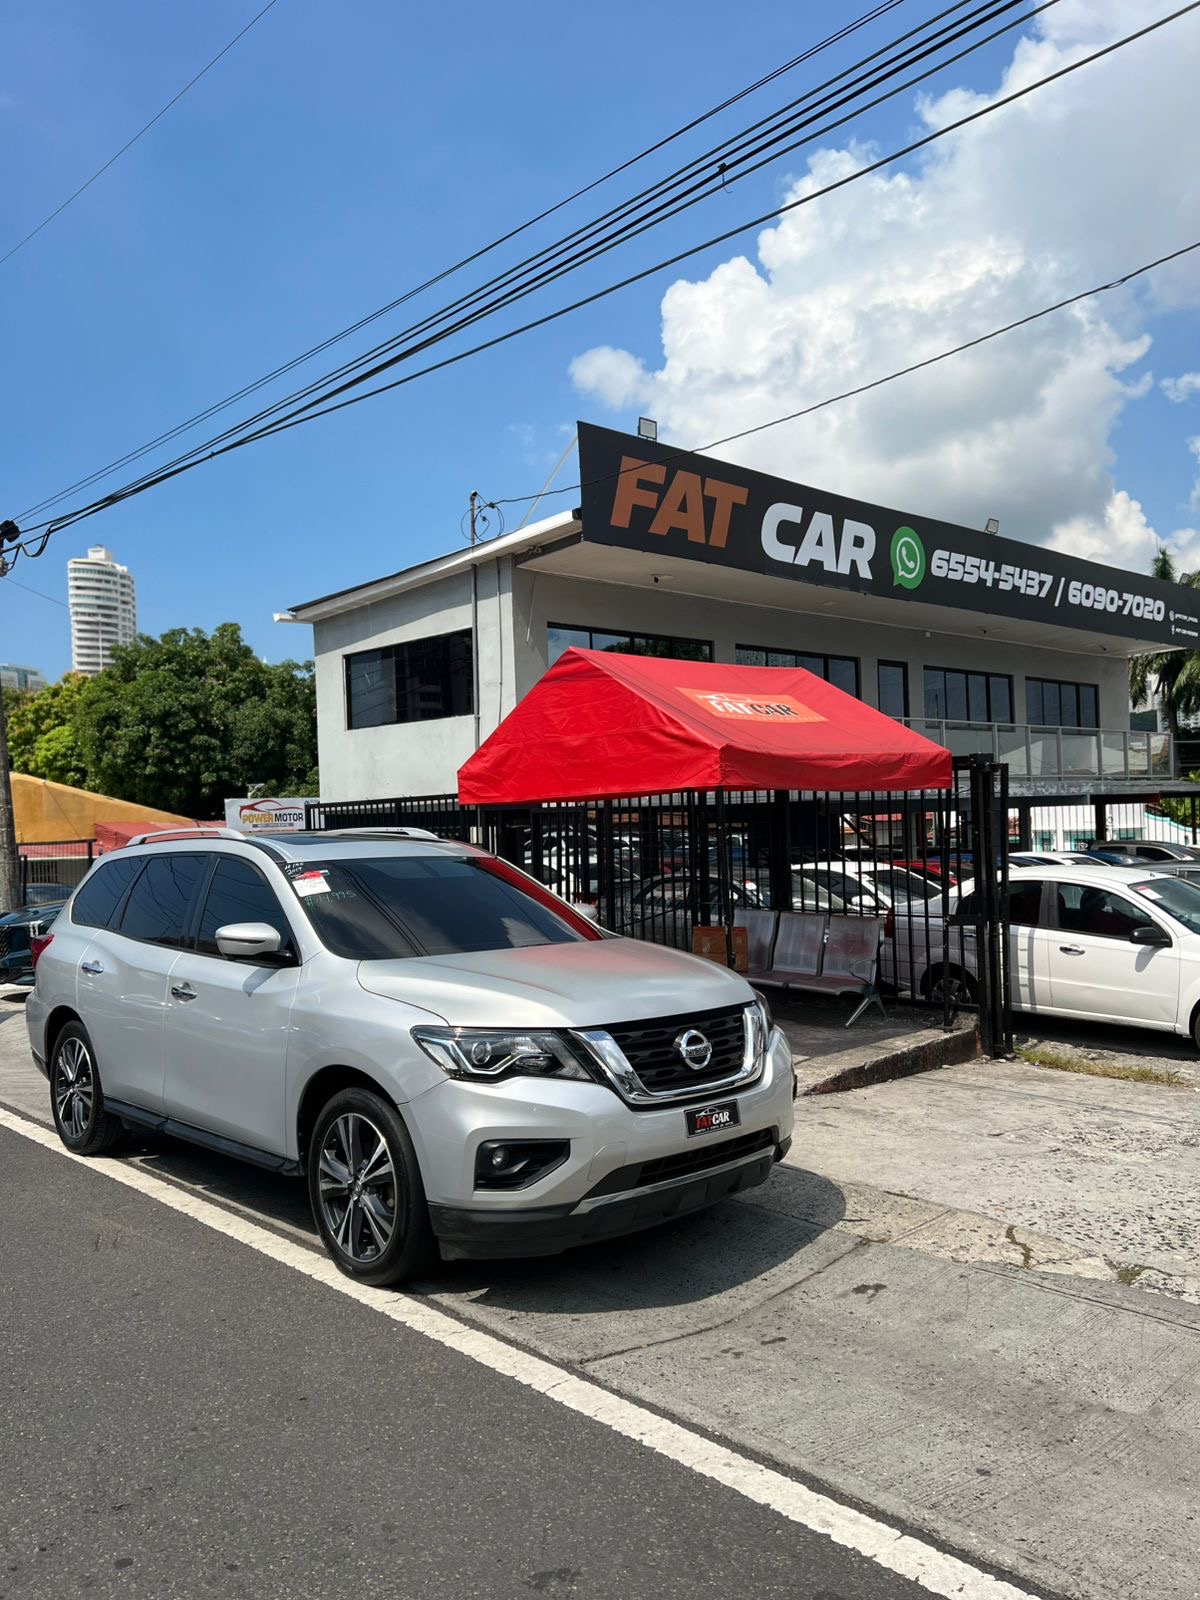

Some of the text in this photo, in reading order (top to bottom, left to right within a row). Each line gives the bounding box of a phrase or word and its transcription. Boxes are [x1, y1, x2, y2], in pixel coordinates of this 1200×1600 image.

[610, 455, 1165, 622] FAT CAR 6554-5437 / 6090-7020
[242, 812, 303, 824] POWER MOTOR
[685, 1044, 711, 1057] NISSAN
